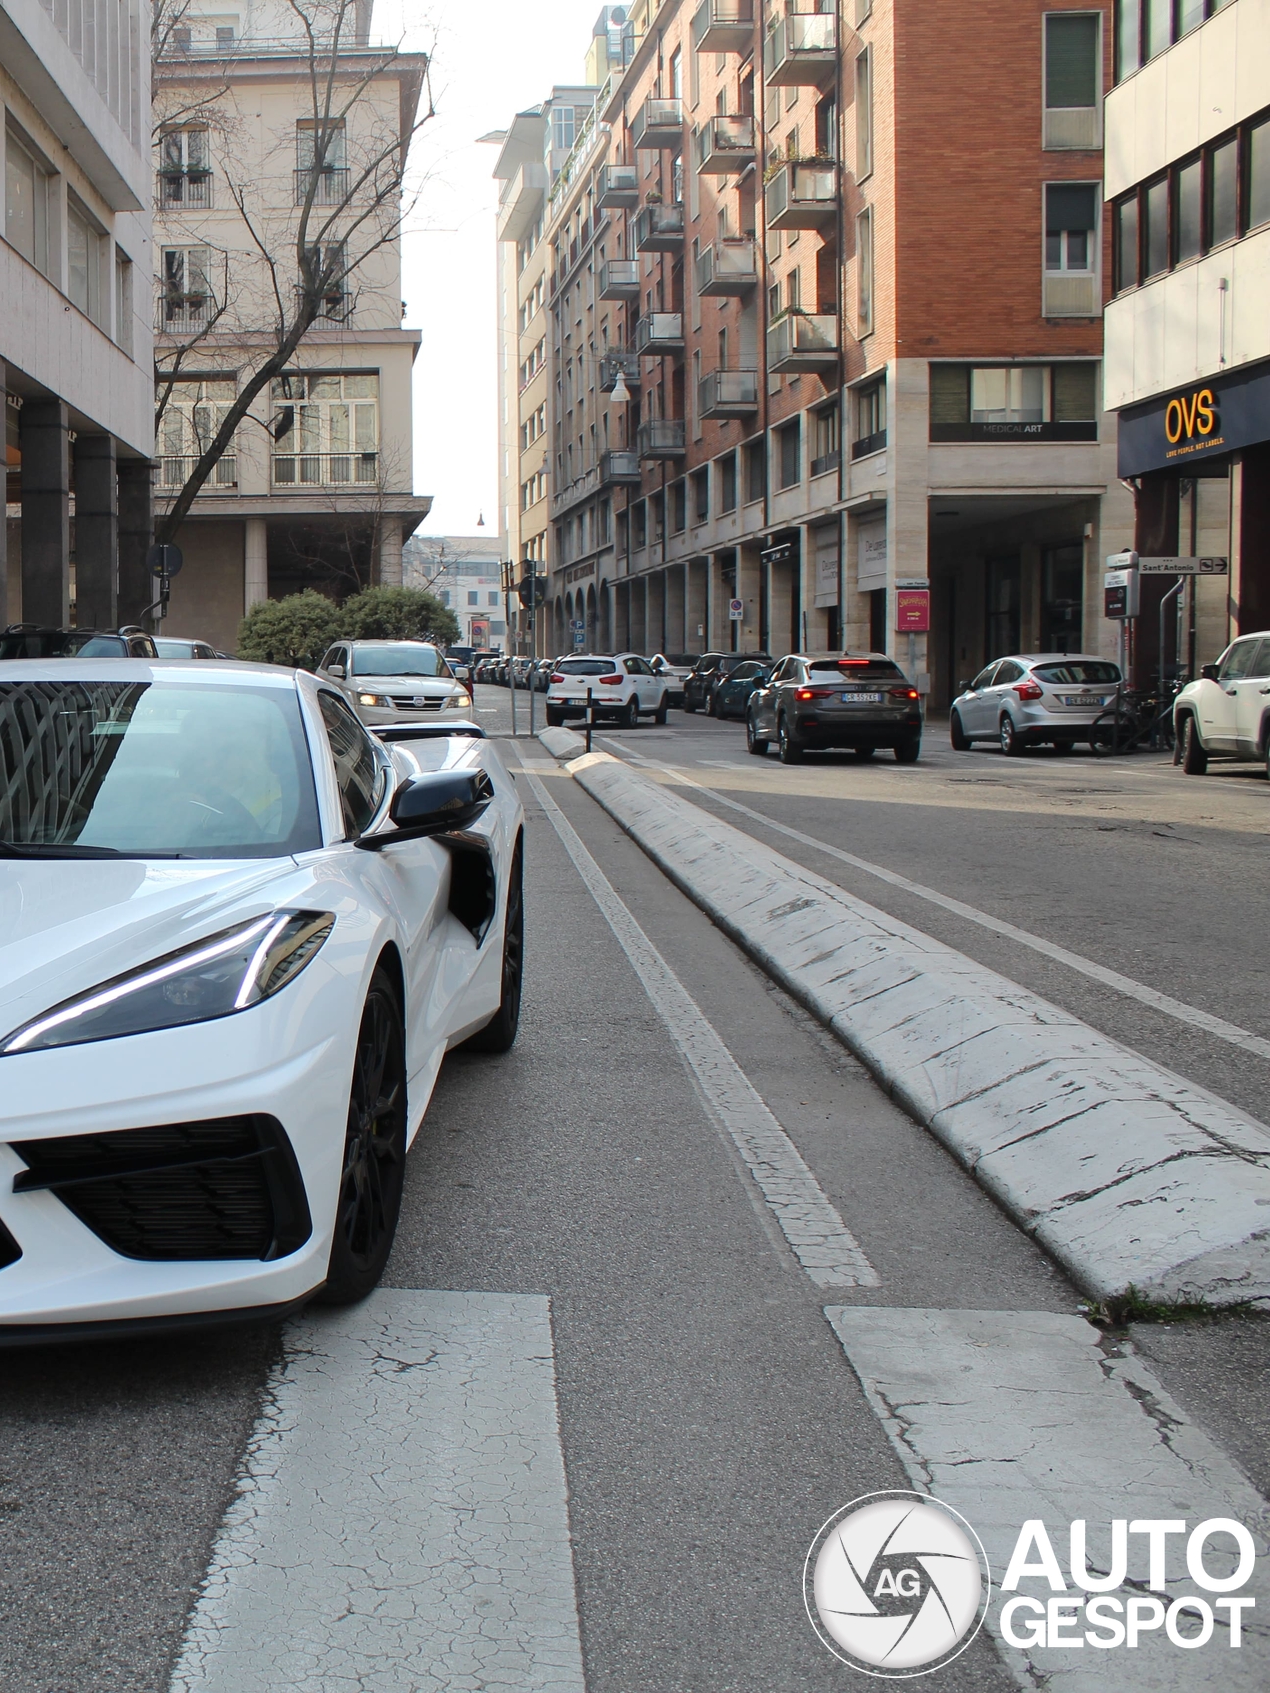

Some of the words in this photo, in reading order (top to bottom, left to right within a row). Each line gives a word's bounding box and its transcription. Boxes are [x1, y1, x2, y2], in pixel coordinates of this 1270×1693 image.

[1165, 389, 1213, 443] OVS
[1166, 449, 1177, 458] LOVE
[1196, 442, 1205, 450] NOT
[576, 621, 583, 629] P
[576, 635, 583, 643] P
